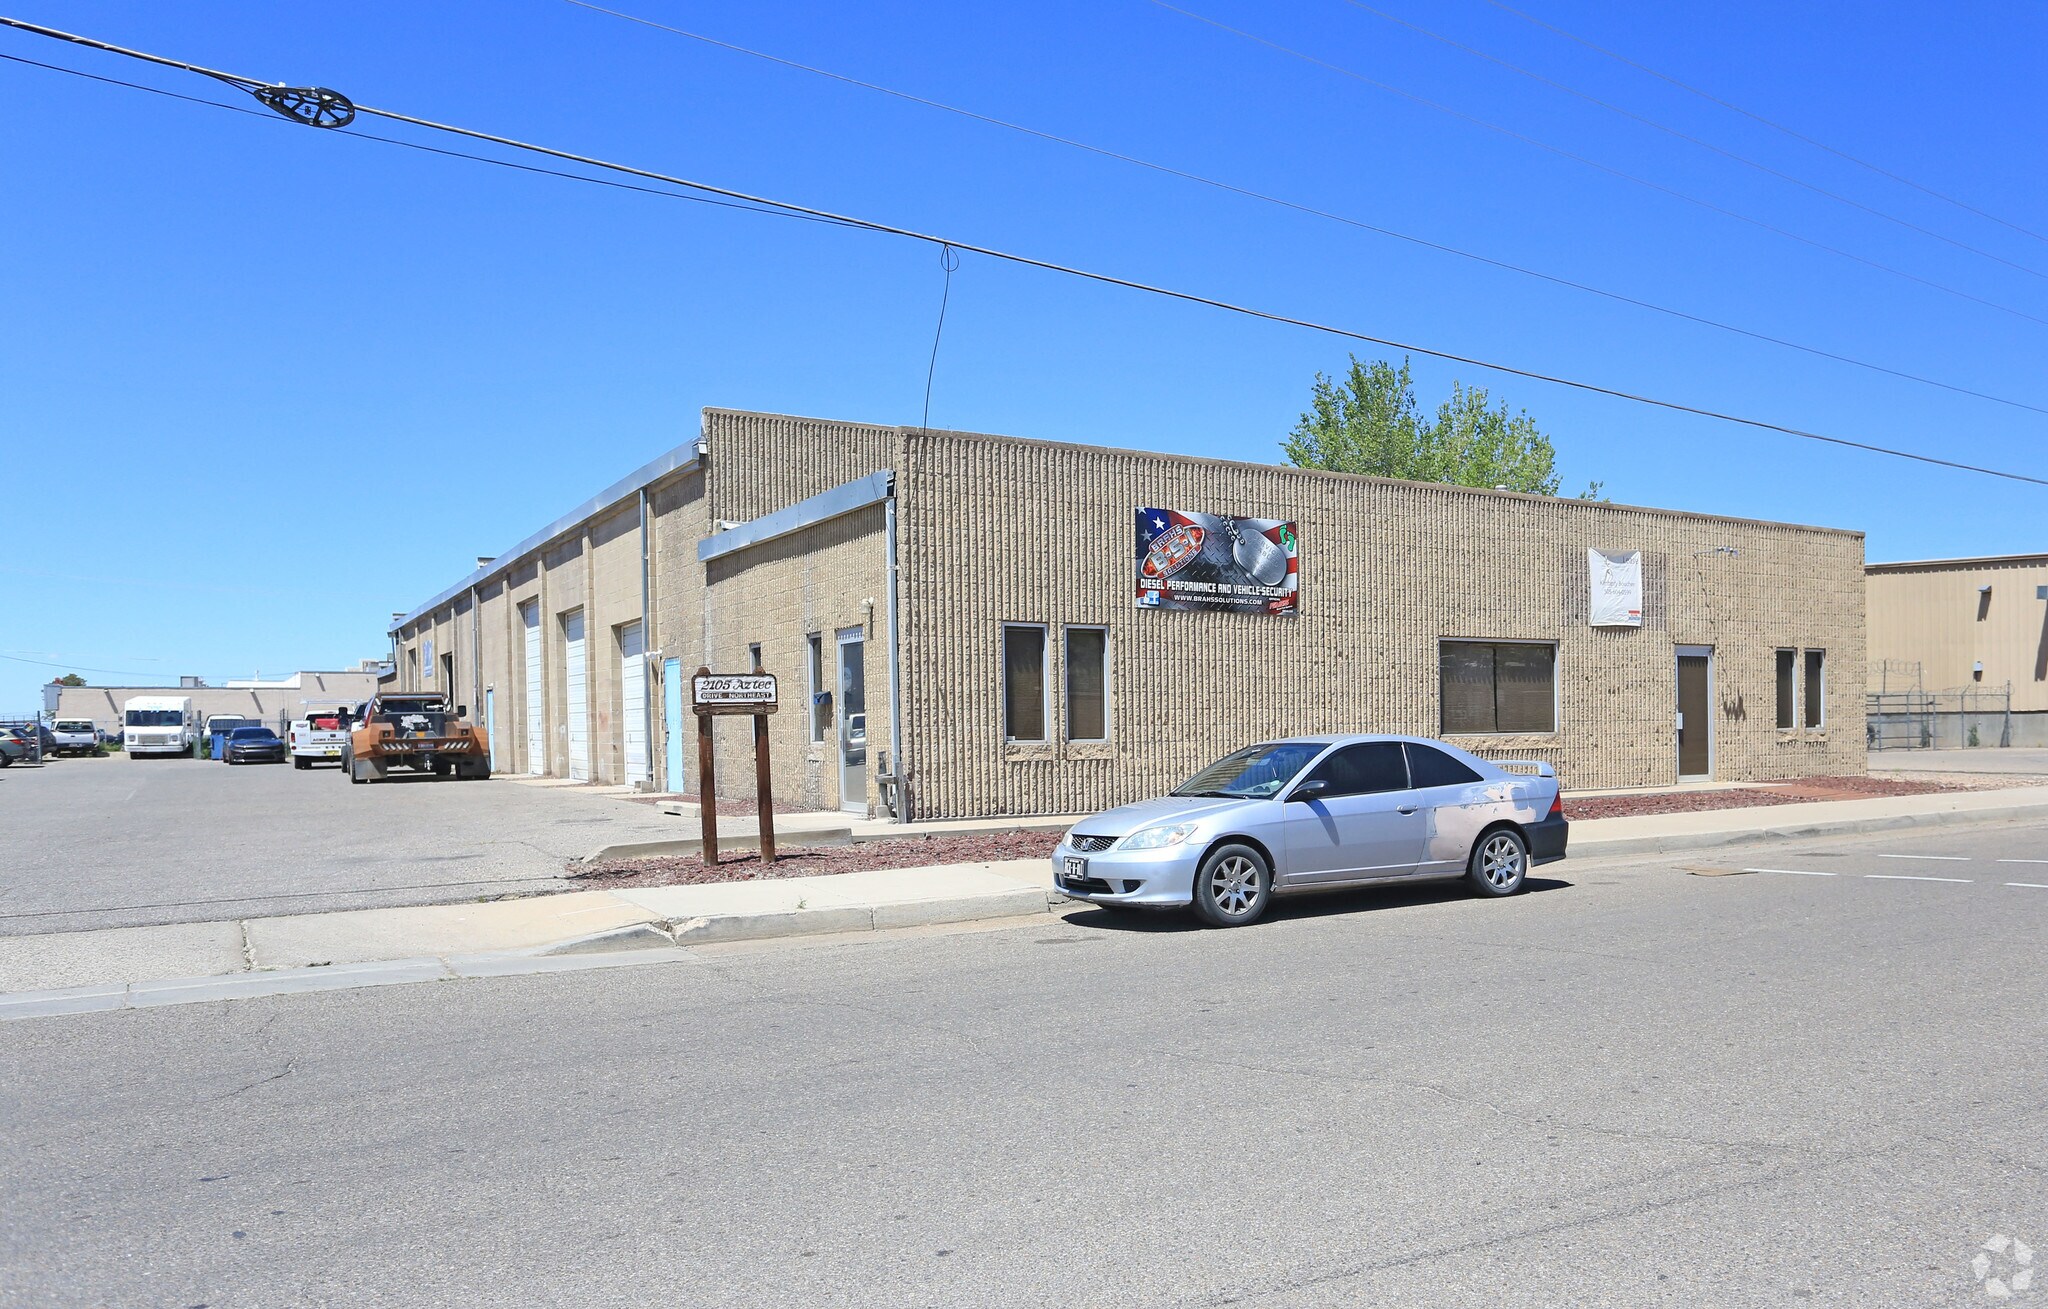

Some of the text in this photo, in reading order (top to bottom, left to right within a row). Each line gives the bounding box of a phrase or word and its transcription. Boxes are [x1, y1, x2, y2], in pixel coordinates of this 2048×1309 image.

[1151, 525, 1183, 550] BRAHS
[1140, 579, 1165, 590] DIESEL
[1166, 580, 1217, 593] PERFORMANCE
[1218, 583, 1232, 594] AND
[1174, 594, 1263, 606] WWW.BRAHSSOLUTIONS.COM
[701, 679, 772, 691] 2105 Aztec
